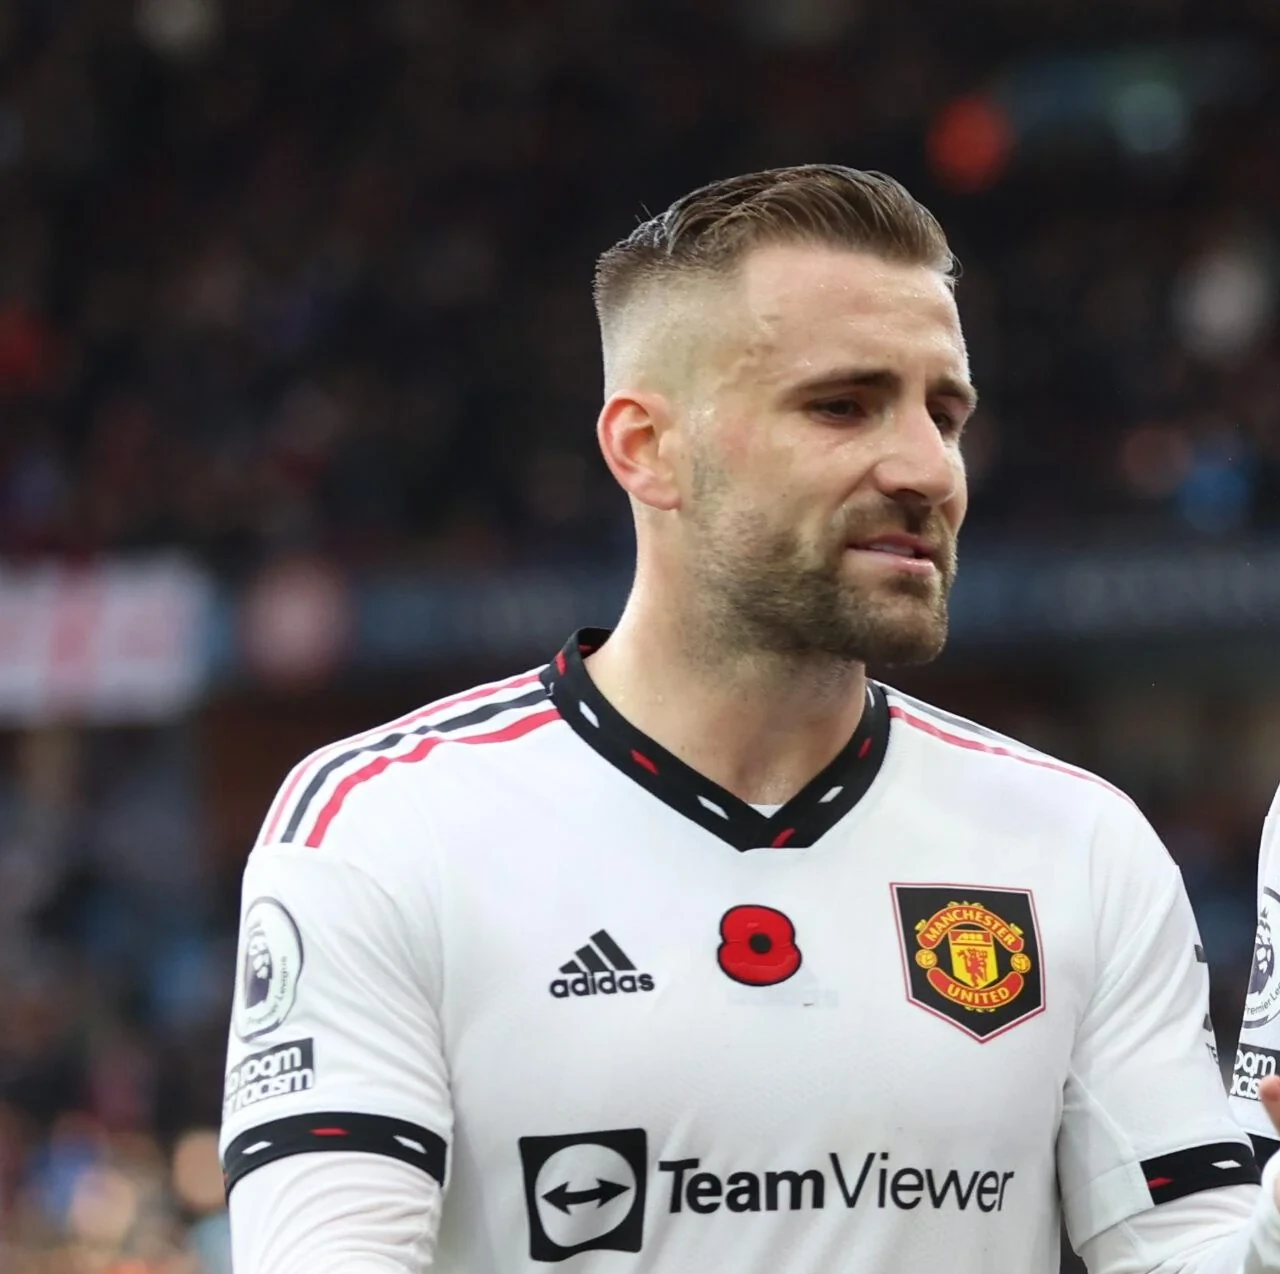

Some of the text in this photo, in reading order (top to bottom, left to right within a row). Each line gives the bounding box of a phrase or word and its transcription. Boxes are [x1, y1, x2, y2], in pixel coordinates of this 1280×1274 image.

[925, 909, 1016, 946] MANCHESTER
[549, 970, 655, 998] adidas
[947, 983, 1010, 1004] UNITED
[658, 1152, 1015, 1214] TeamViewer
